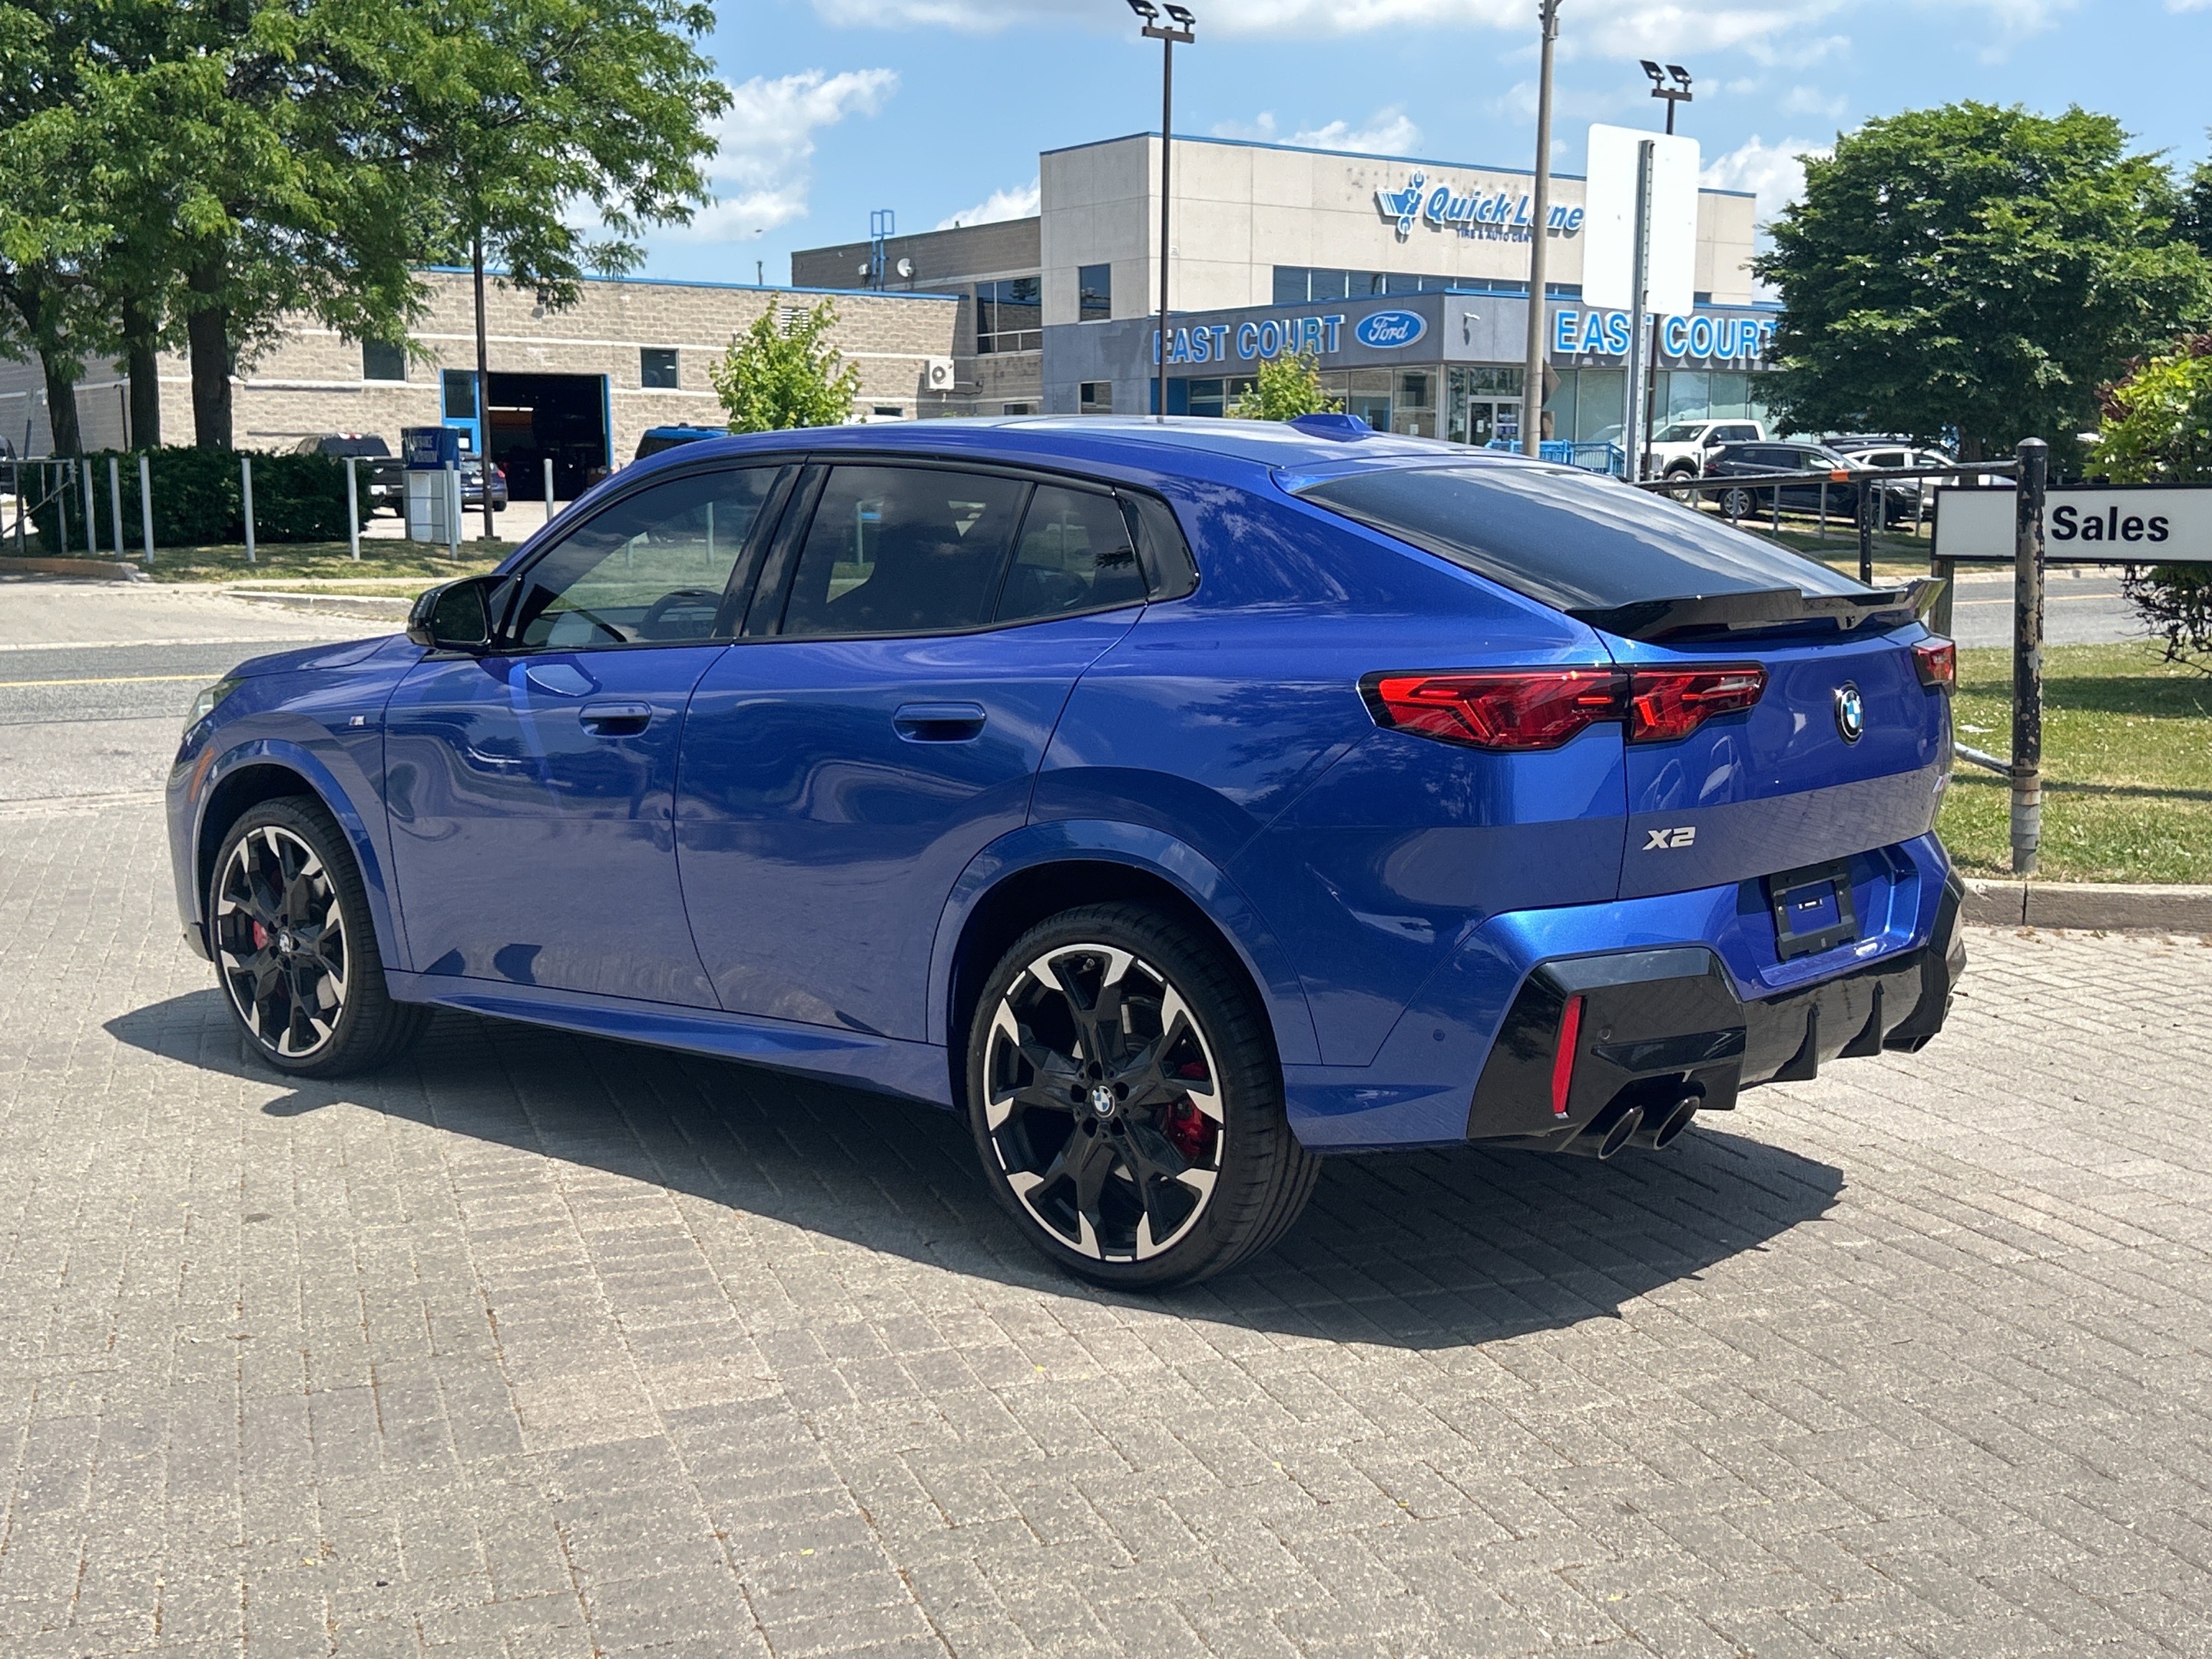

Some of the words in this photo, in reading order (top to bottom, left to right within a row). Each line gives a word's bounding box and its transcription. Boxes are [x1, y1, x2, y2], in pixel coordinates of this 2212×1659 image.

[1426, 185, 1512, 224] Quick
[1512, 194, 1585, 230] Lne
[1456, 227, 1475, 240] TIRE
[1485, 230, 1510, 242] AUTO
[1237, 314, 1345, 359] COURT
[1368, 316, 1410, 342] Ford
[2051, 505, 2170, 542] Sales
[1641, 826, 1697, 851] X2
